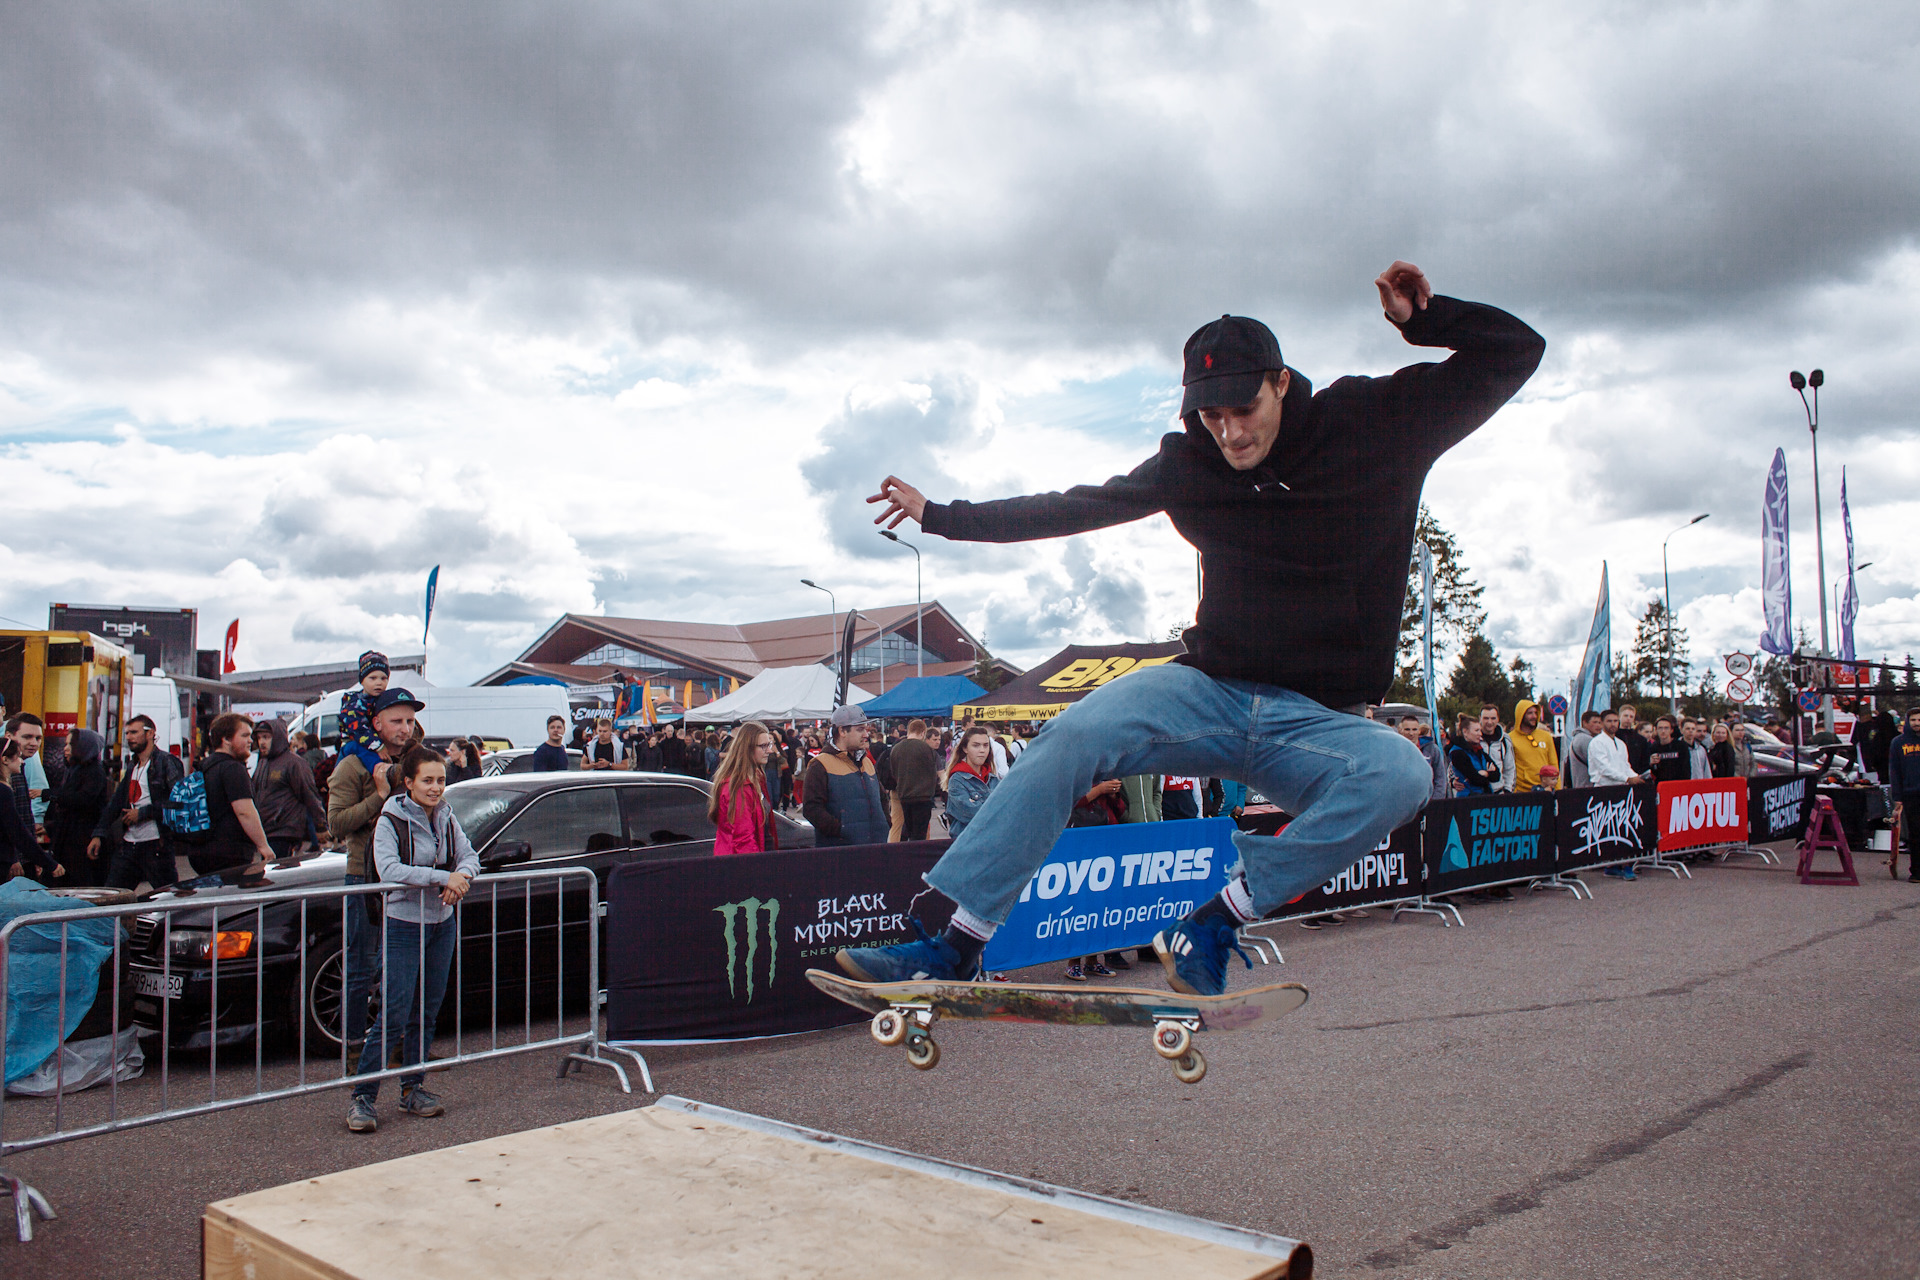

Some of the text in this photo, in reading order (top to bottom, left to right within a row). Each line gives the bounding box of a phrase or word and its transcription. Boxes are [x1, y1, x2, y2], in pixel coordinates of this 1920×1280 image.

[102, 620, 147, 637] hgk
[574, 707, 617, 721] EMPIRE
[1763, 777, 1806, 815] TSUNAMI
[1469, 805, 1542, 837] TSUNAMI
[1668, 791, 1740, 835] MOTUL
[1769, 801, 1802, 833] PICNIC
[1470, 834, 1541, 867] FACTORY
[1120, 847, 1215, 888] TIRES
[817, 892, 887, 918] BLACK
[1102, 906, 1123, 927] to
[1123, 896, 1194, 931] perform
[860, 937, 900, 949] DRINK
